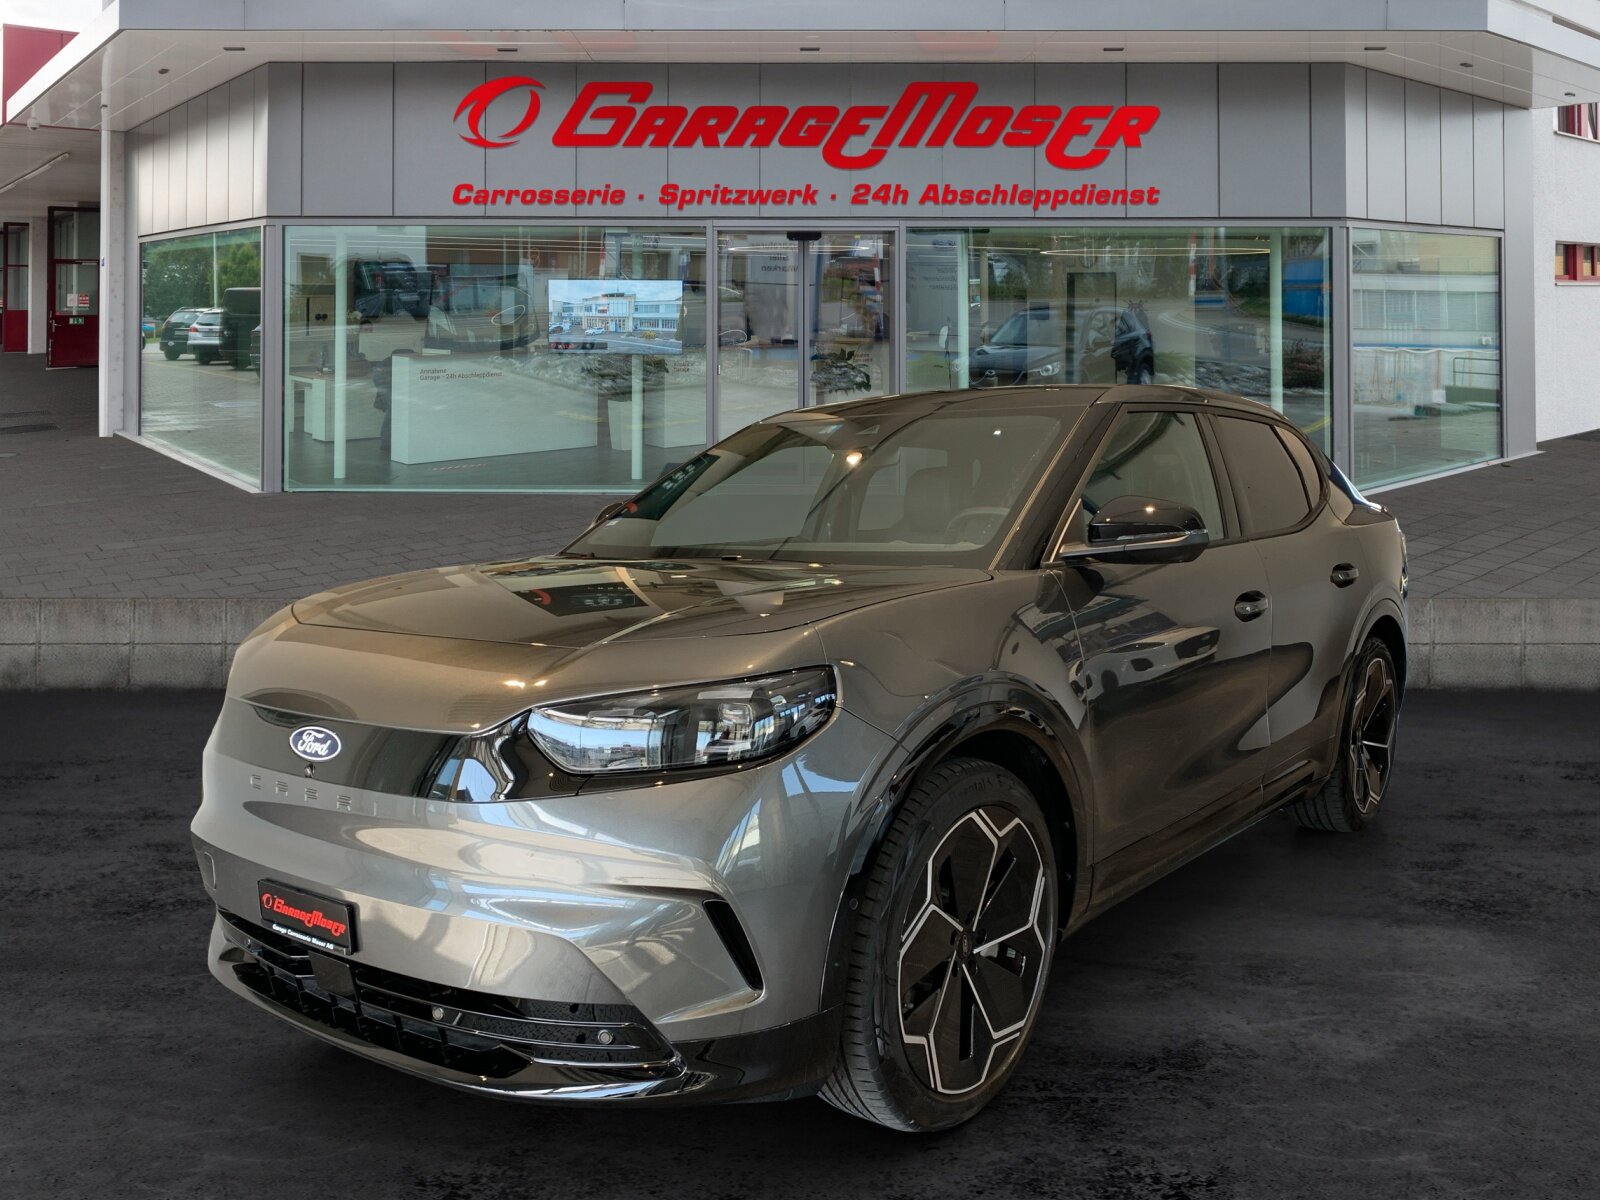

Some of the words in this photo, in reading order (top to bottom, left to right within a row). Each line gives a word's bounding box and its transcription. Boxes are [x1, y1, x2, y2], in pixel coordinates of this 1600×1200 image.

[452, 183, 626, 205] Carrosserie
[658, 183, 818, 210] Spritzwerk
[850, 183, 910, 205] 24h
[918, 183, 1160, 211] Abschleppdienst
[297, 730, 331, 756] Ford
